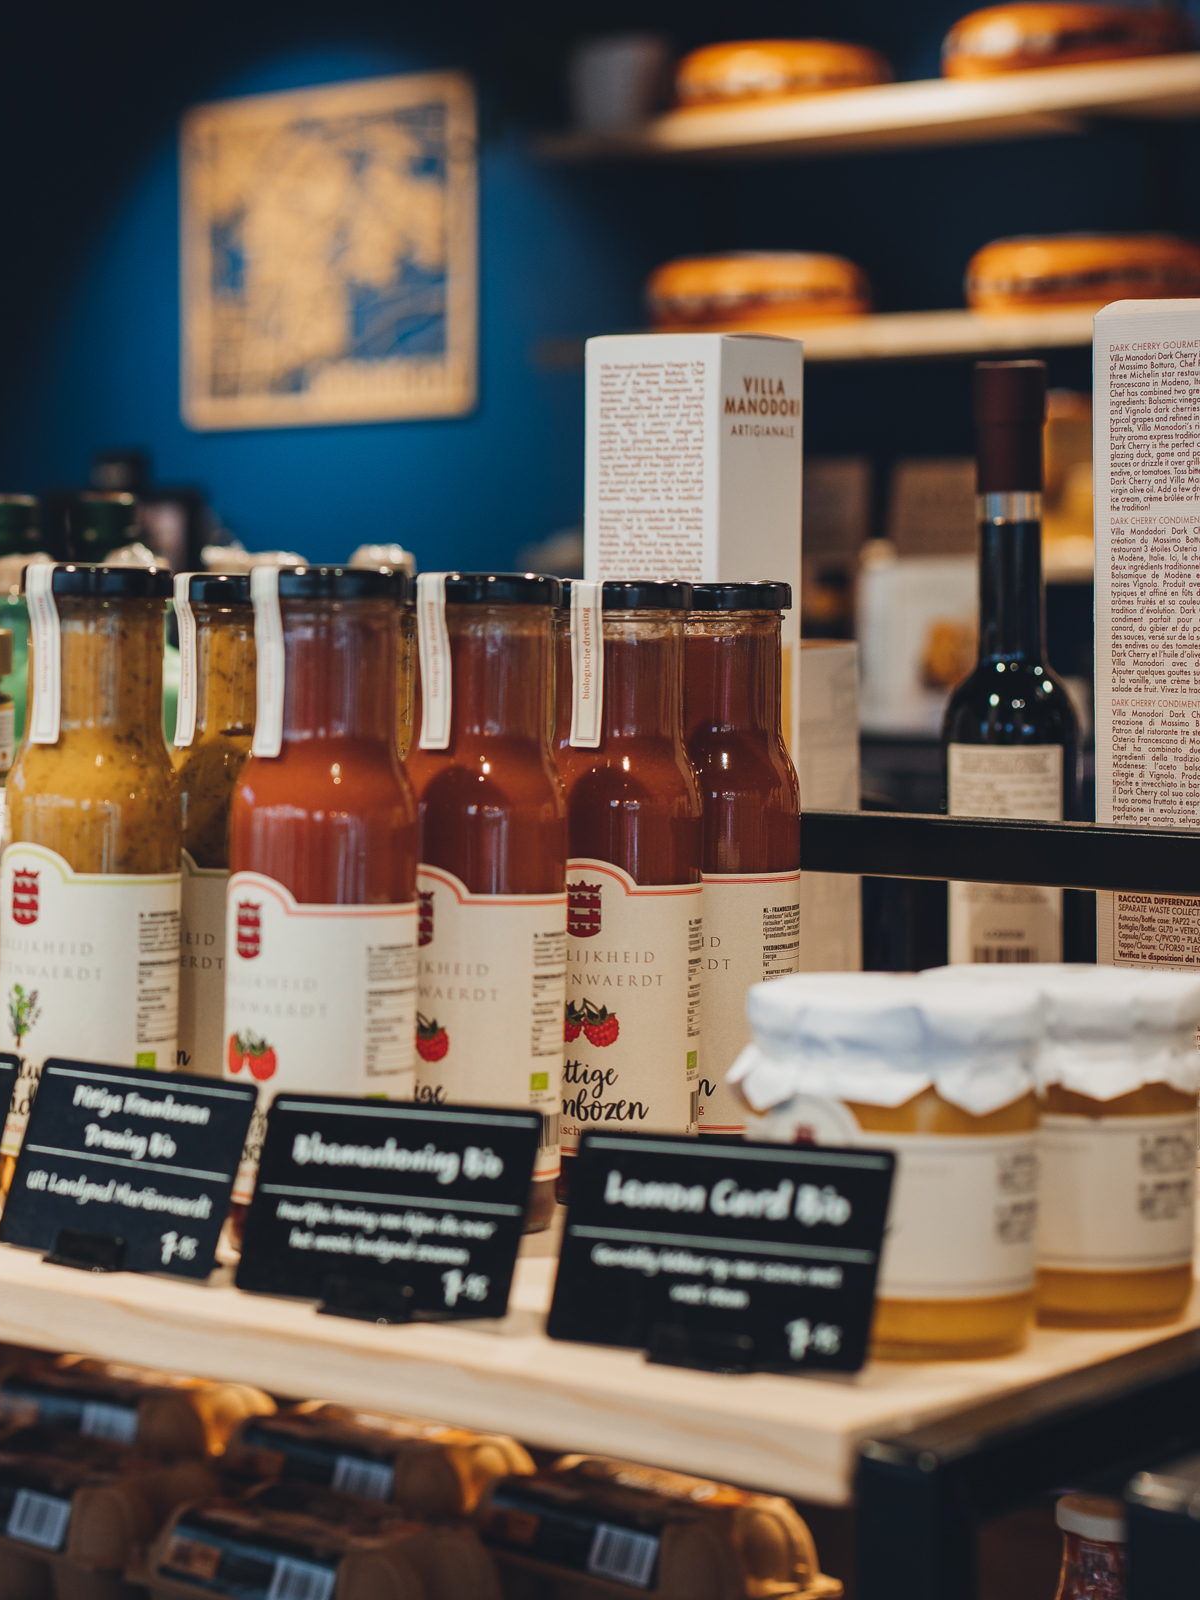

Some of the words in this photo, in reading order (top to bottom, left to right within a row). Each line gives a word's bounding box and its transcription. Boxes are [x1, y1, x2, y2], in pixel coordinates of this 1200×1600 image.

[1110, 344, 1129, 352] DARK
[1132, 342, 1160, 351] CHERRY
[1125, 353, 1156, 361] Manodori
[1158, 352, 1173, 360] Dark
[1175, 351, 1197, 360] Cherry
[1110, 363, 1116, 371] of
[743, 376, 785, 396] VILLA
[1161, 378, 1191, 386] Modena,
[724, 397, 800, 417] MANODORI
[730, 424, 795, 439] ARTIGIANALE
[1128, 441, 1150, 451] Cherry
[1171, 440, 1195, 450] perfect
[1110, 487, 1128, 495] virgin
[1157, 485, 1171, 493] Add
[1179, 484, 1190, 492] few
[1122, 503, 1150, 511] tradition!
[1172, 526, 1187, 534] Dark
[582, 607, 591, 646] dressing
[582, 649, 592, 699] biologische
[1131, 699, 1156, 707] CHERRY
[1135, 727, 1144, 735] del
[148, 1131, 177, 1159] Bio
[604, 1169, 707, 1213] Lemon
